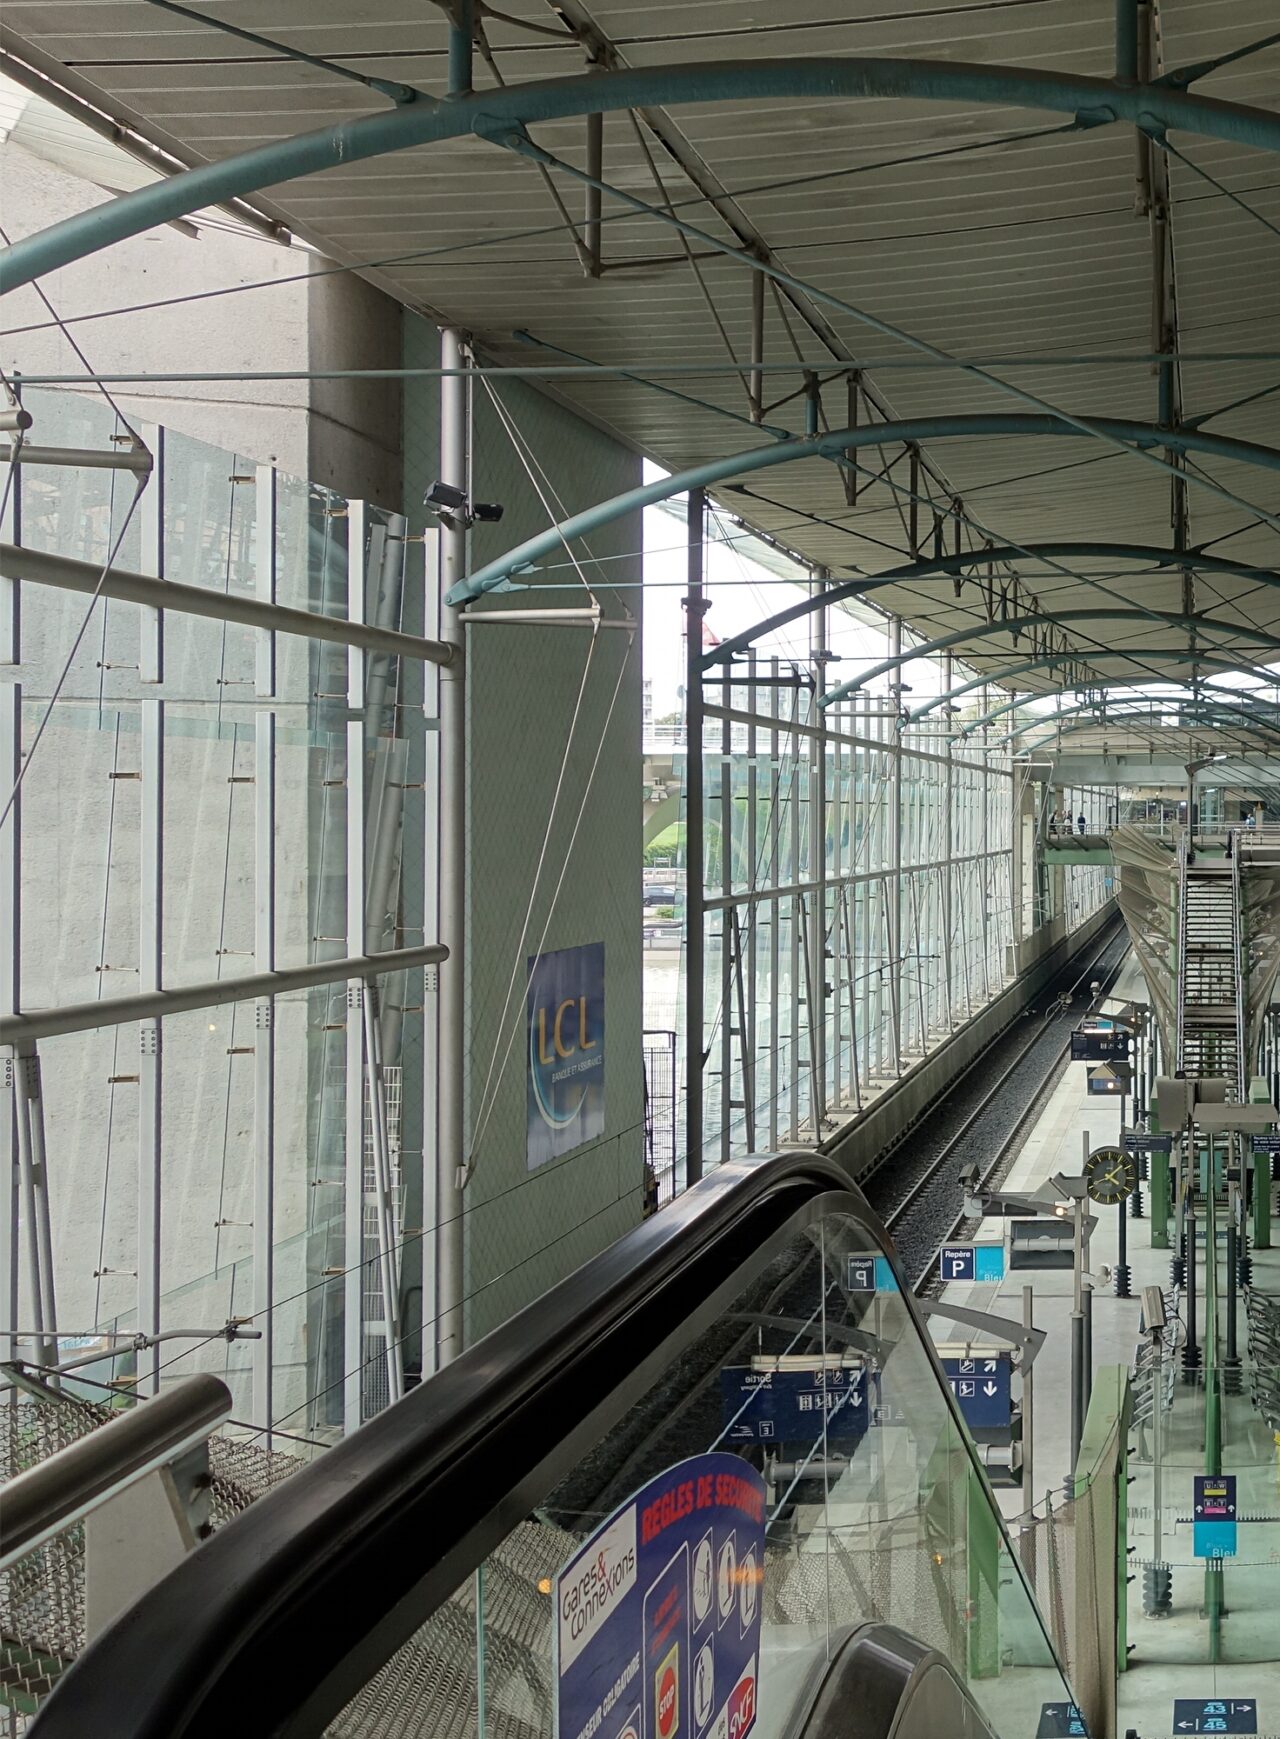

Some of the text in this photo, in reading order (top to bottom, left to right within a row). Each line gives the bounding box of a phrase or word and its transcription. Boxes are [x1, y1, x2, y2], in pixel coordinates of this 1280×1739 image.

[538, 996, 596, 1066] LCL
[552, 1067, 571, 1083] BANQUE
[945, 1250, 971, 1259] Repère
[952, 1261, 965, 1277] P
[641, 1480, 694, 1546] REGLES
[695, 1474, 713, 1509] DE
[658, 1684, 675, 1720] STOP
[1203, 1705, 1227, 1713] 43
[730, 1683, 753, 1738] SNCF
[1203, 1721, 1227, 1729] 45
